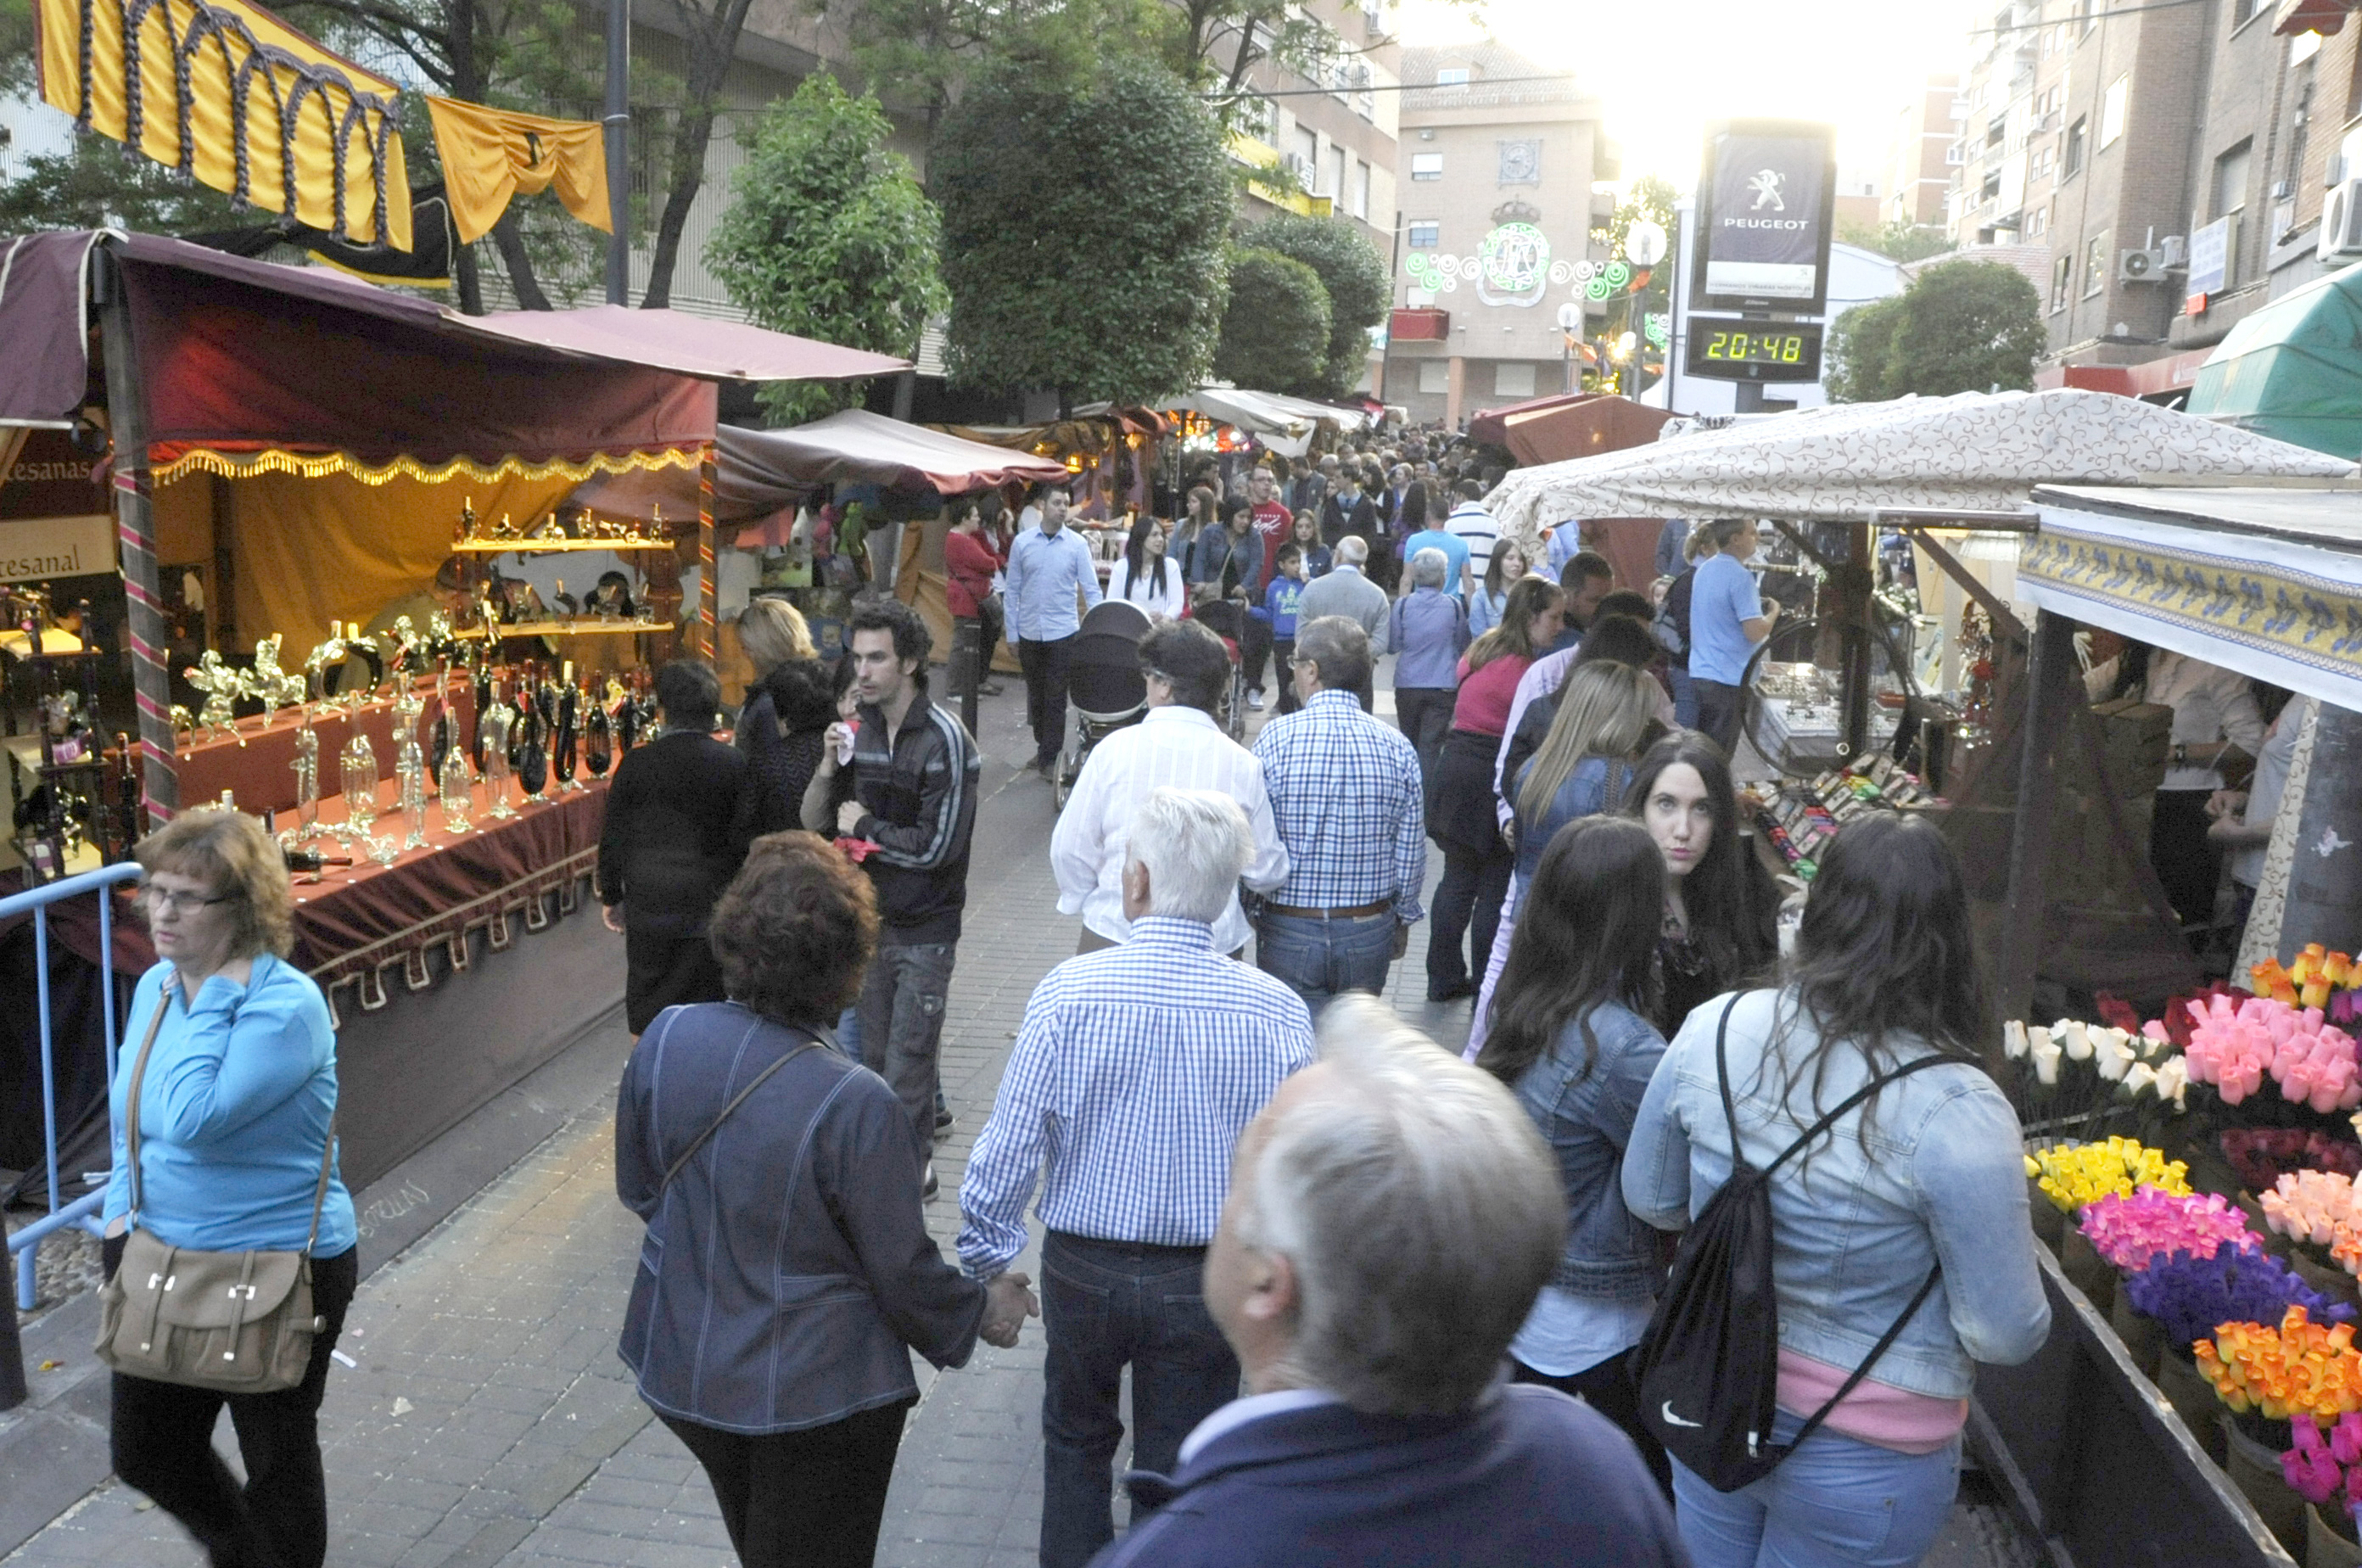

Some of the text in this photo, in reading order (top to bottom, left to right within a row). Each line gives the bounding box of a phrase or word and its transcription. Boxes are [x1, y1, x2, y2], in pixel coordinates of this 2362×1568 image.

[1724, 217, 1809, 231] PEUGEOT
[1707, 333, 1801, 362] 20:48
[6, 461, 91, 482] esanas
